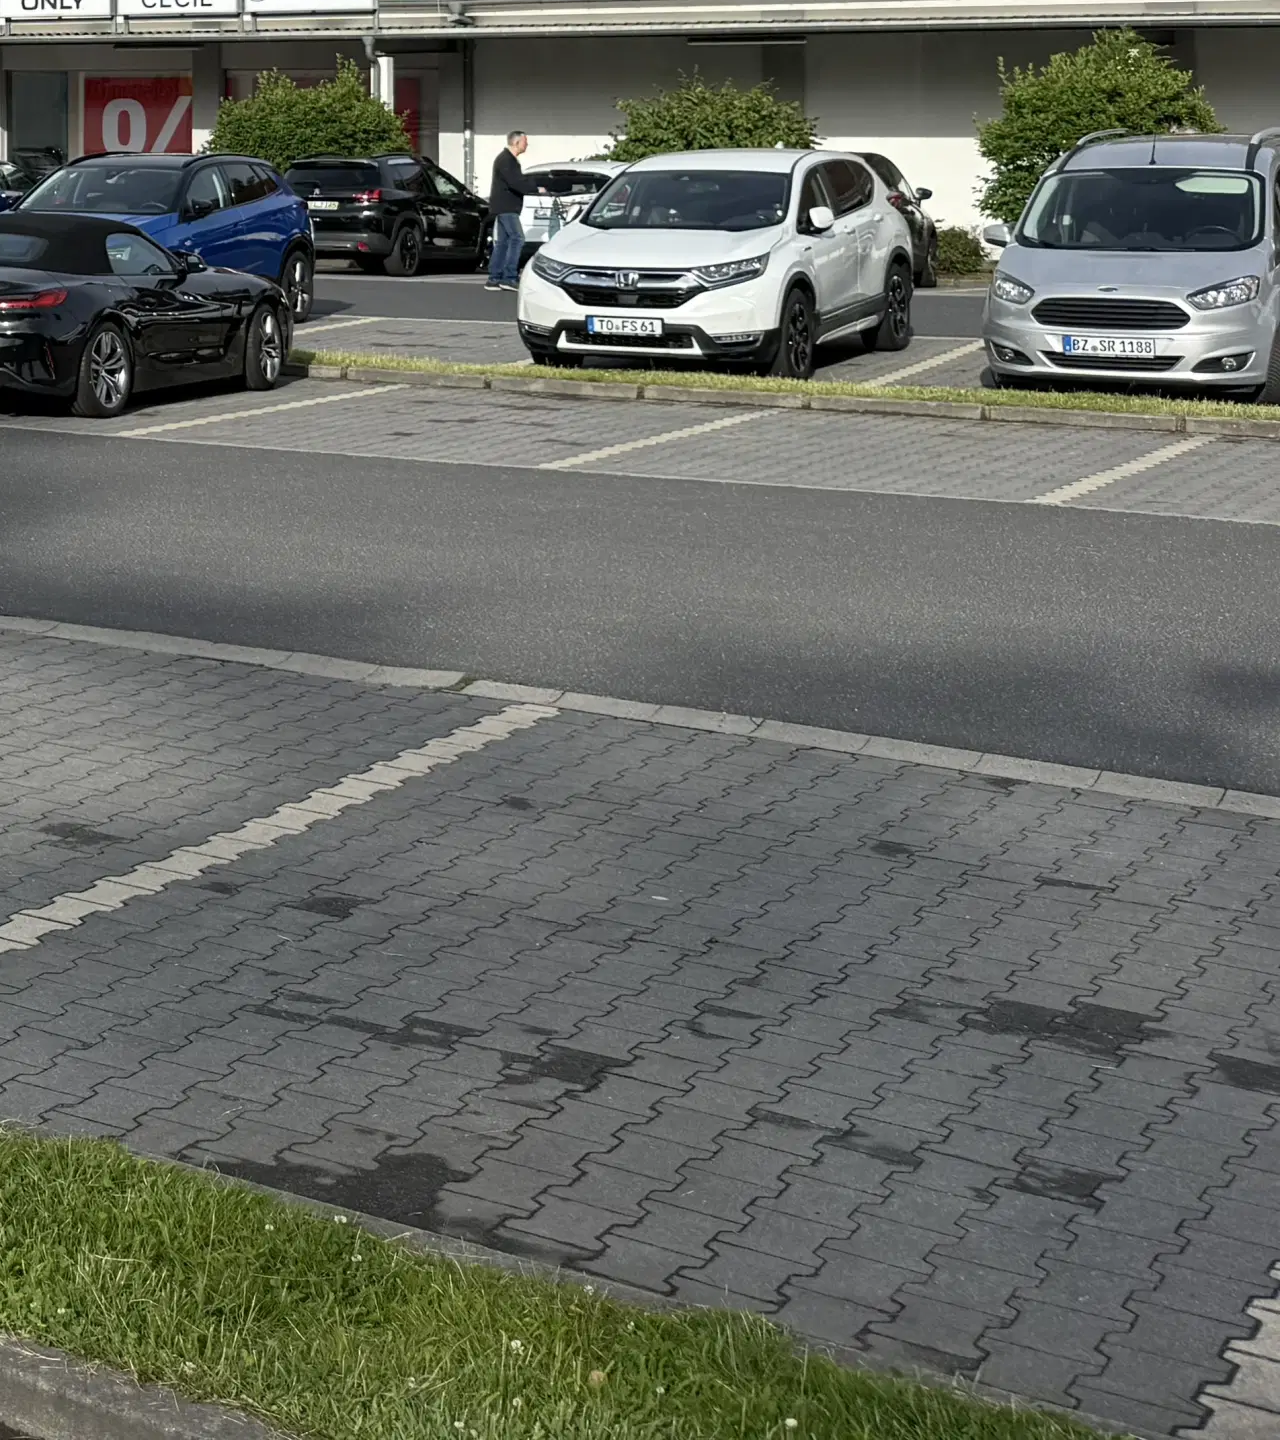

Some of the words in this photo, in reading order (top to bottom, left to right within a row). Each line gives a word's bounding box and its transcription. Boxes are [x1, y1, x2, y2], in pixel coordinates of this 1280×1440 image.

[598, 319, 613, 330] TO
[622, 320, 638, 331] FS
[640, 321, 656, 332] 61
[1072, 339, 1089, 351] BZ
[1099, 340, 1116, 352] SR
[1119, 341, 1152, 354] 1188
